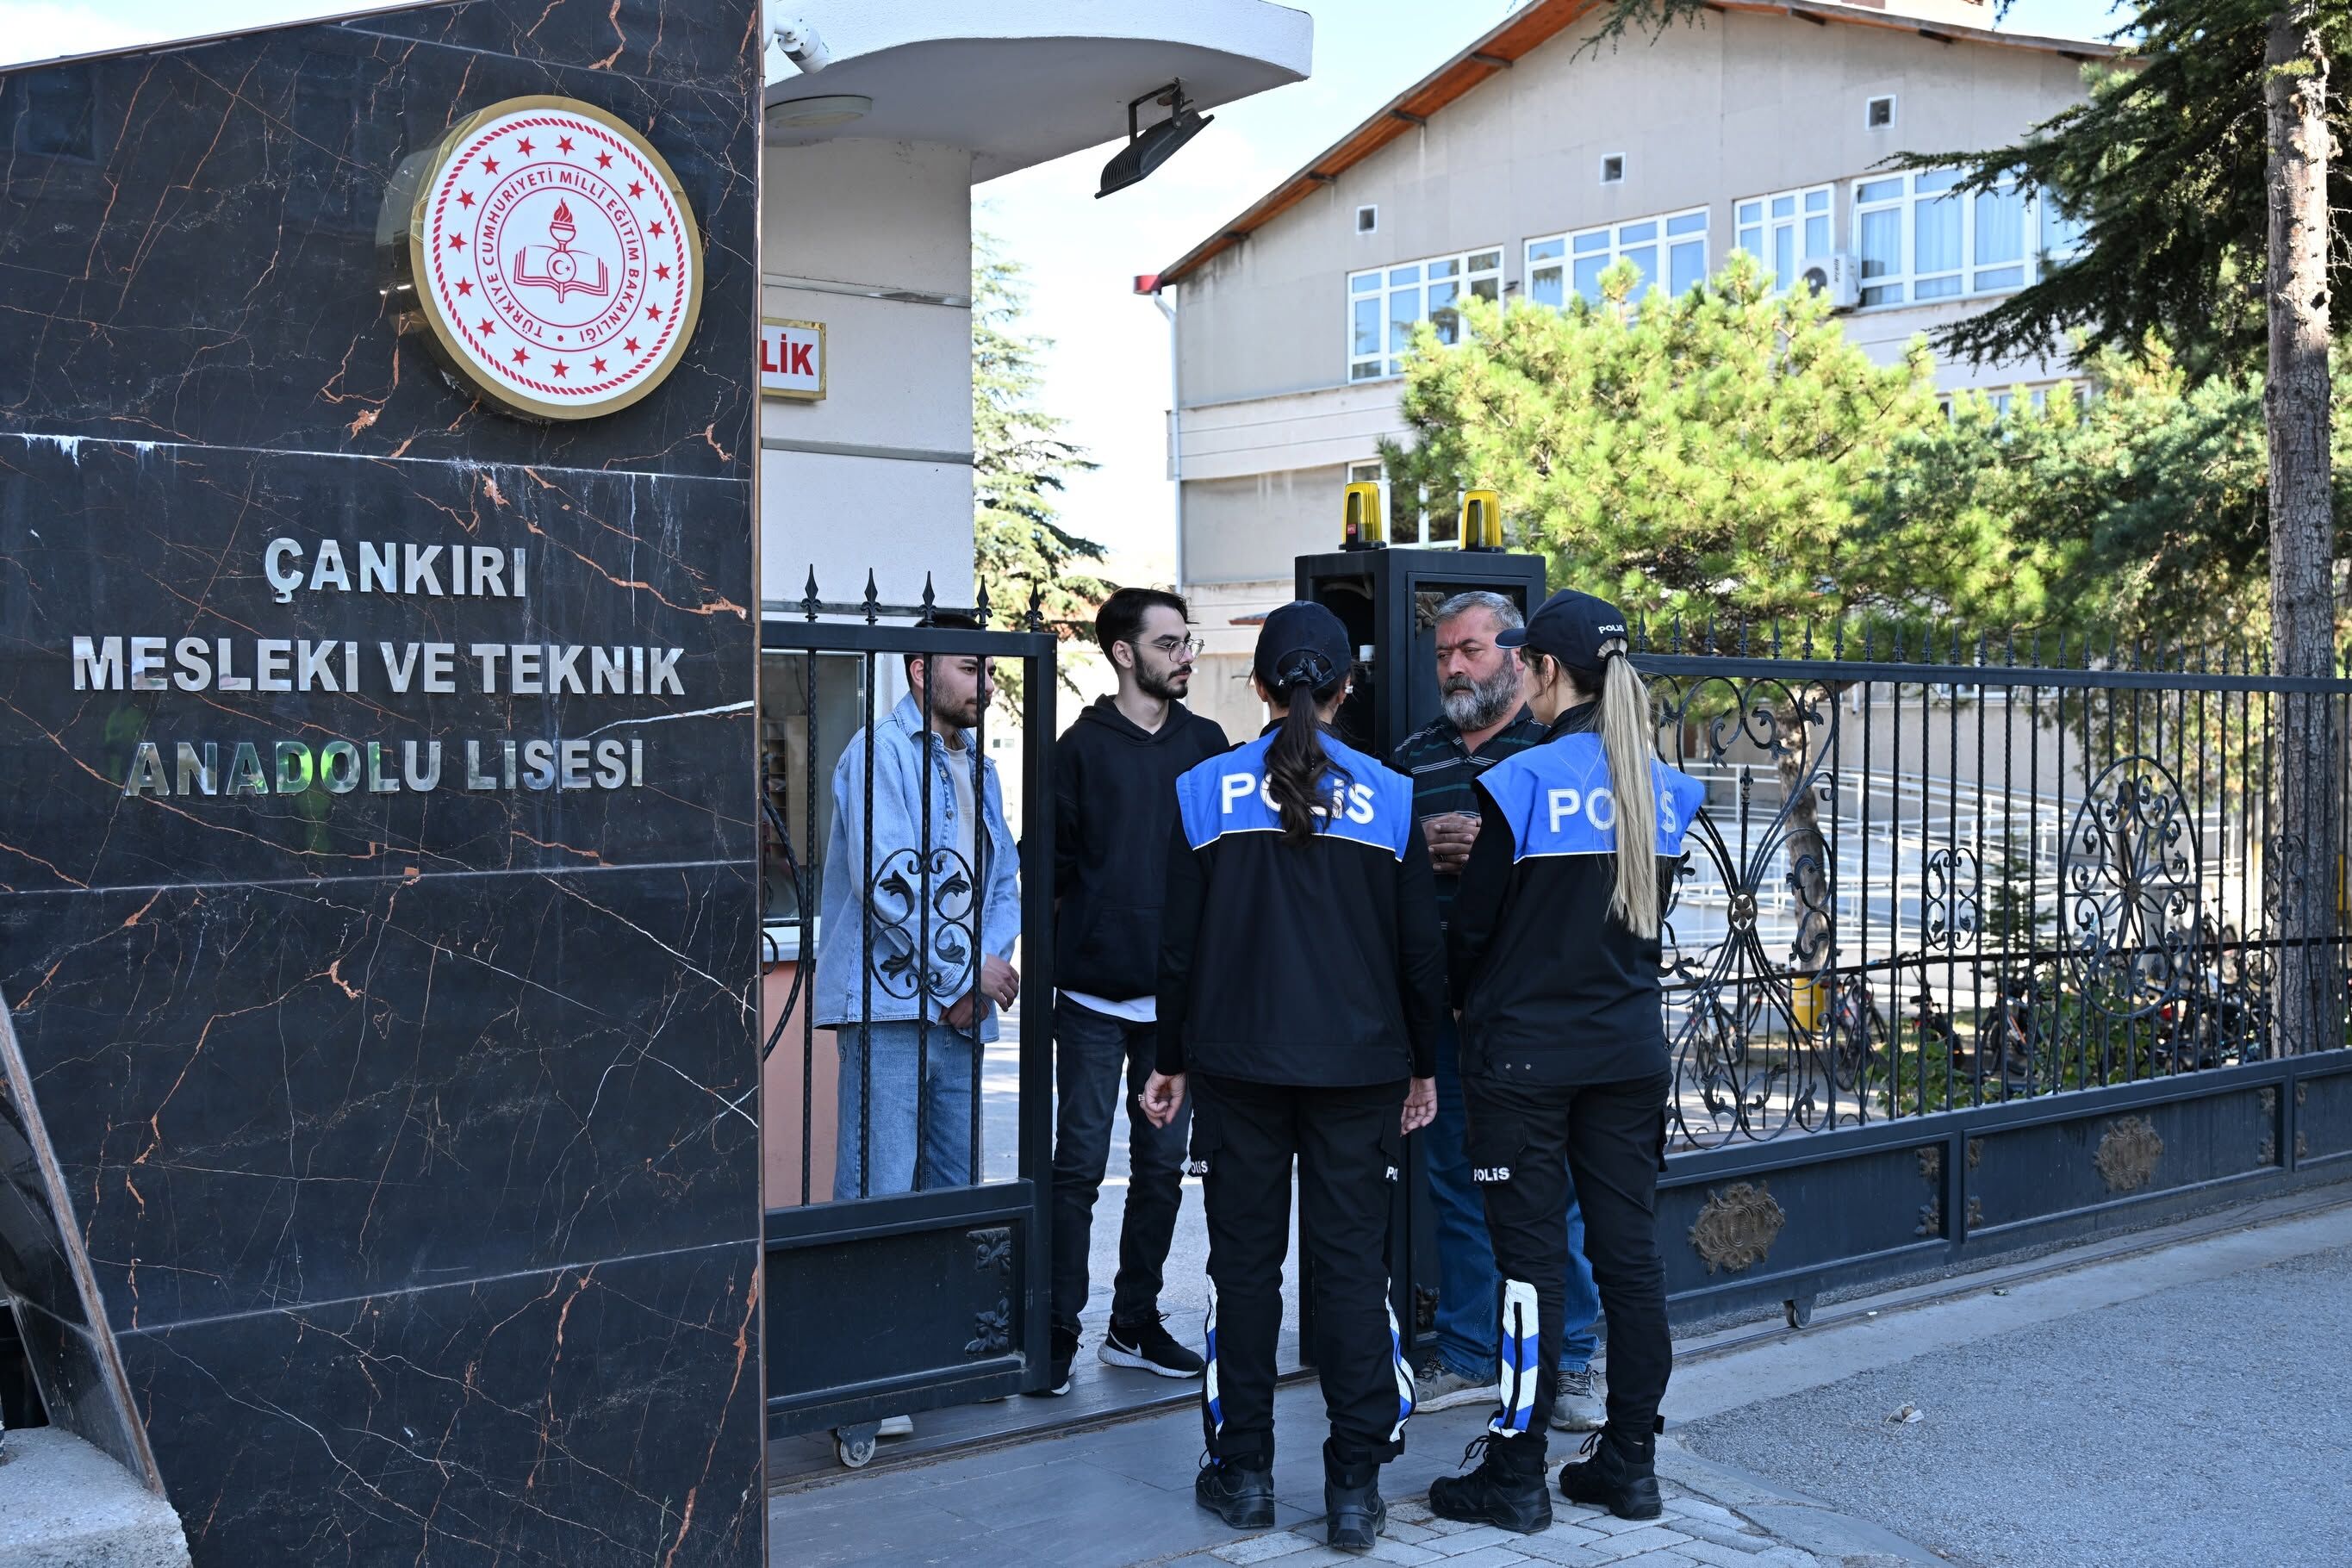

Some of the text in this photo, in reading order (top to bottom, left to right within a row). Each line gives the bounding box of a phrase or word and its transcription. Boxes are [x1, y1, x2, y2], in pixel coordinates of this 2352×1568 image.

[481, 166, 553, 266] CUMHURİYETİ
[606, 198, 640, 261] EĞİTİM
[486, 272, 543, 339] TÜRKİYE
[579, 268, 640, 343] BAKANLIĞI
[264, 537, 526, 604] ÇANKIRI
[379, 641, 456, 694] VE
[124, 740, 442, 797] ANADOLU
[1547, 787, 1677, 834] POS
